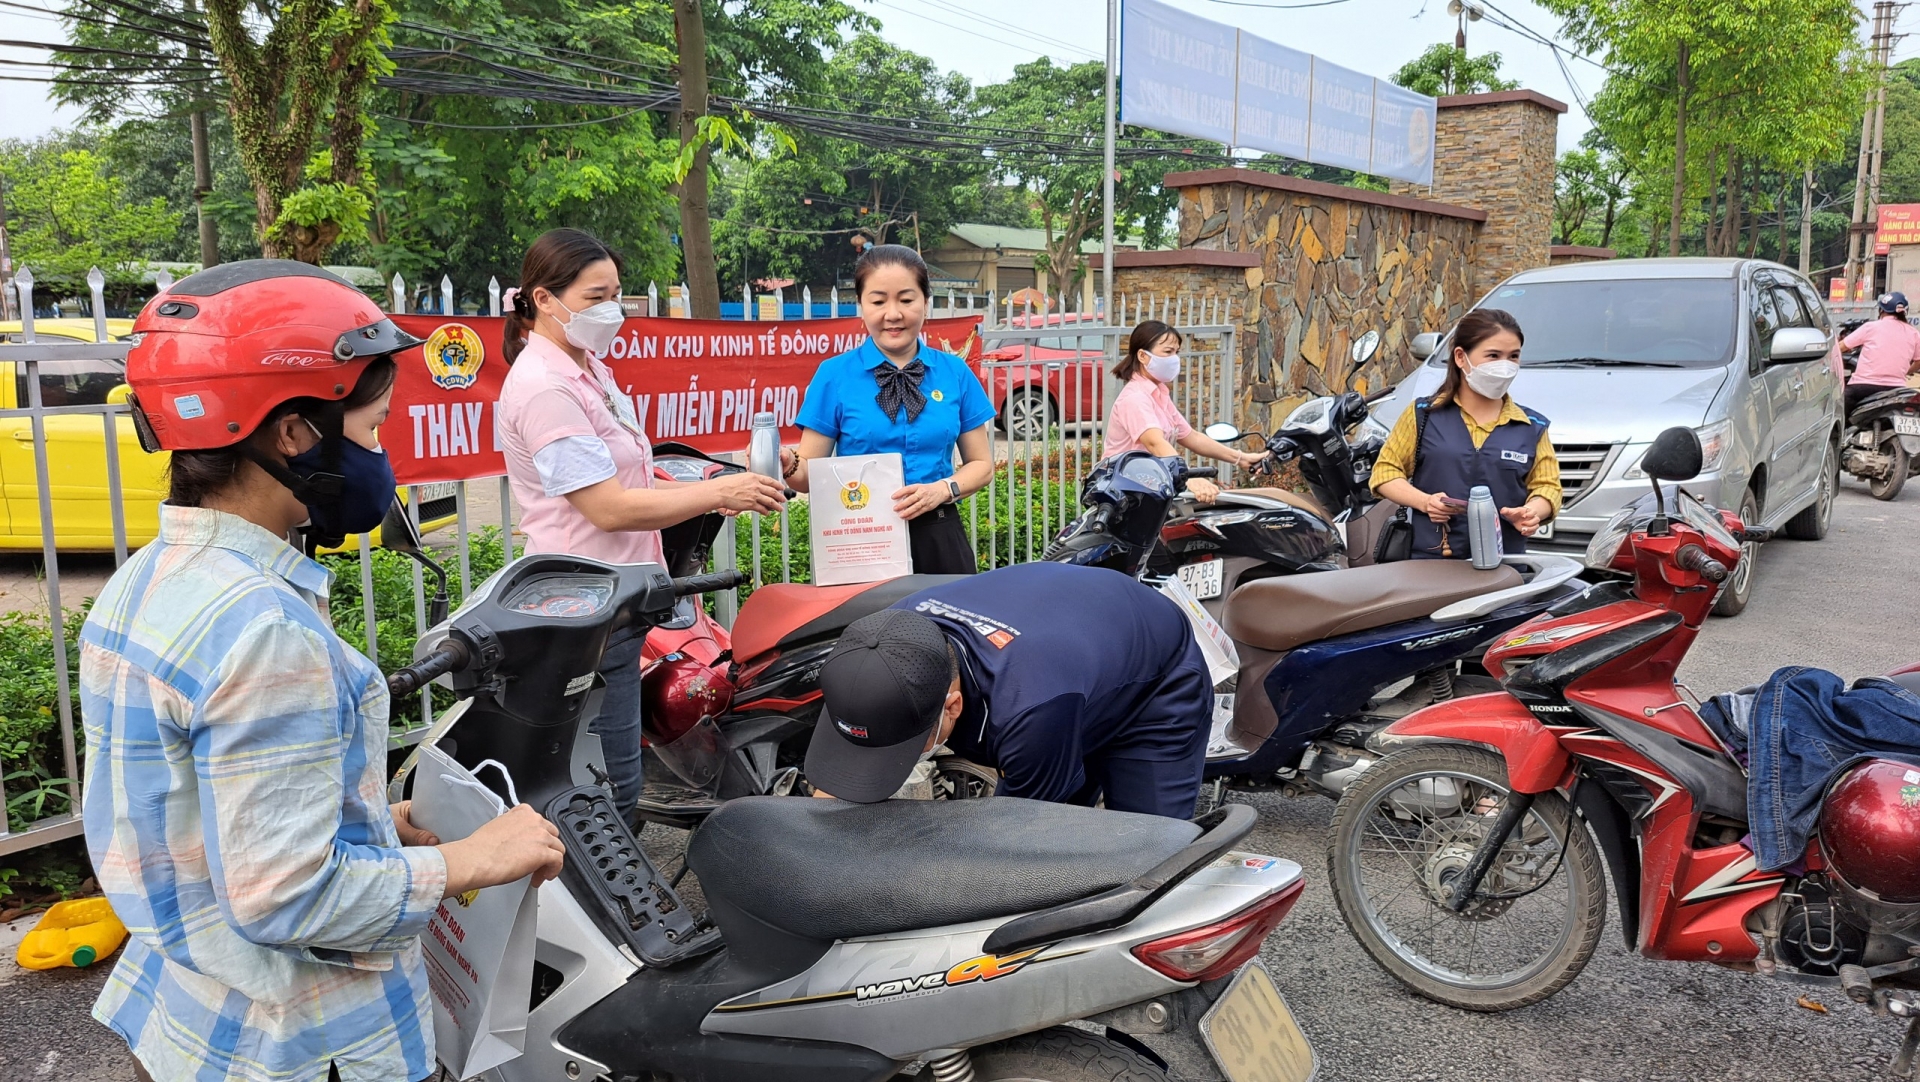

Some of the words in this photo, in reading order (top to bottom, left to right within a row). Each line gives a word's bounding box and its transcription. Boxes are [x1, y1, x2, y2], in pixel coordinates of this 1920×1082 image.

[664, 335, 704, 358] KHU
[710, 335, 753, 357] KINH
[758, 326, 778, 356] TẾ
[781, 329, 830, 356] ĐÔNG
[408, 401, 483, 459] THAY
[656, 374, 715, 439] MIỄN
[719, 379, 757, 433] PHÍ
[761, 385, 798, 428] CHO
[1183, 562, 1215, 582] 37-B3
[1401, 625, 1484, 650] VISION
[878, 994, 911, 1004] FASHION
[915, 988, 942, 997] MOVER
